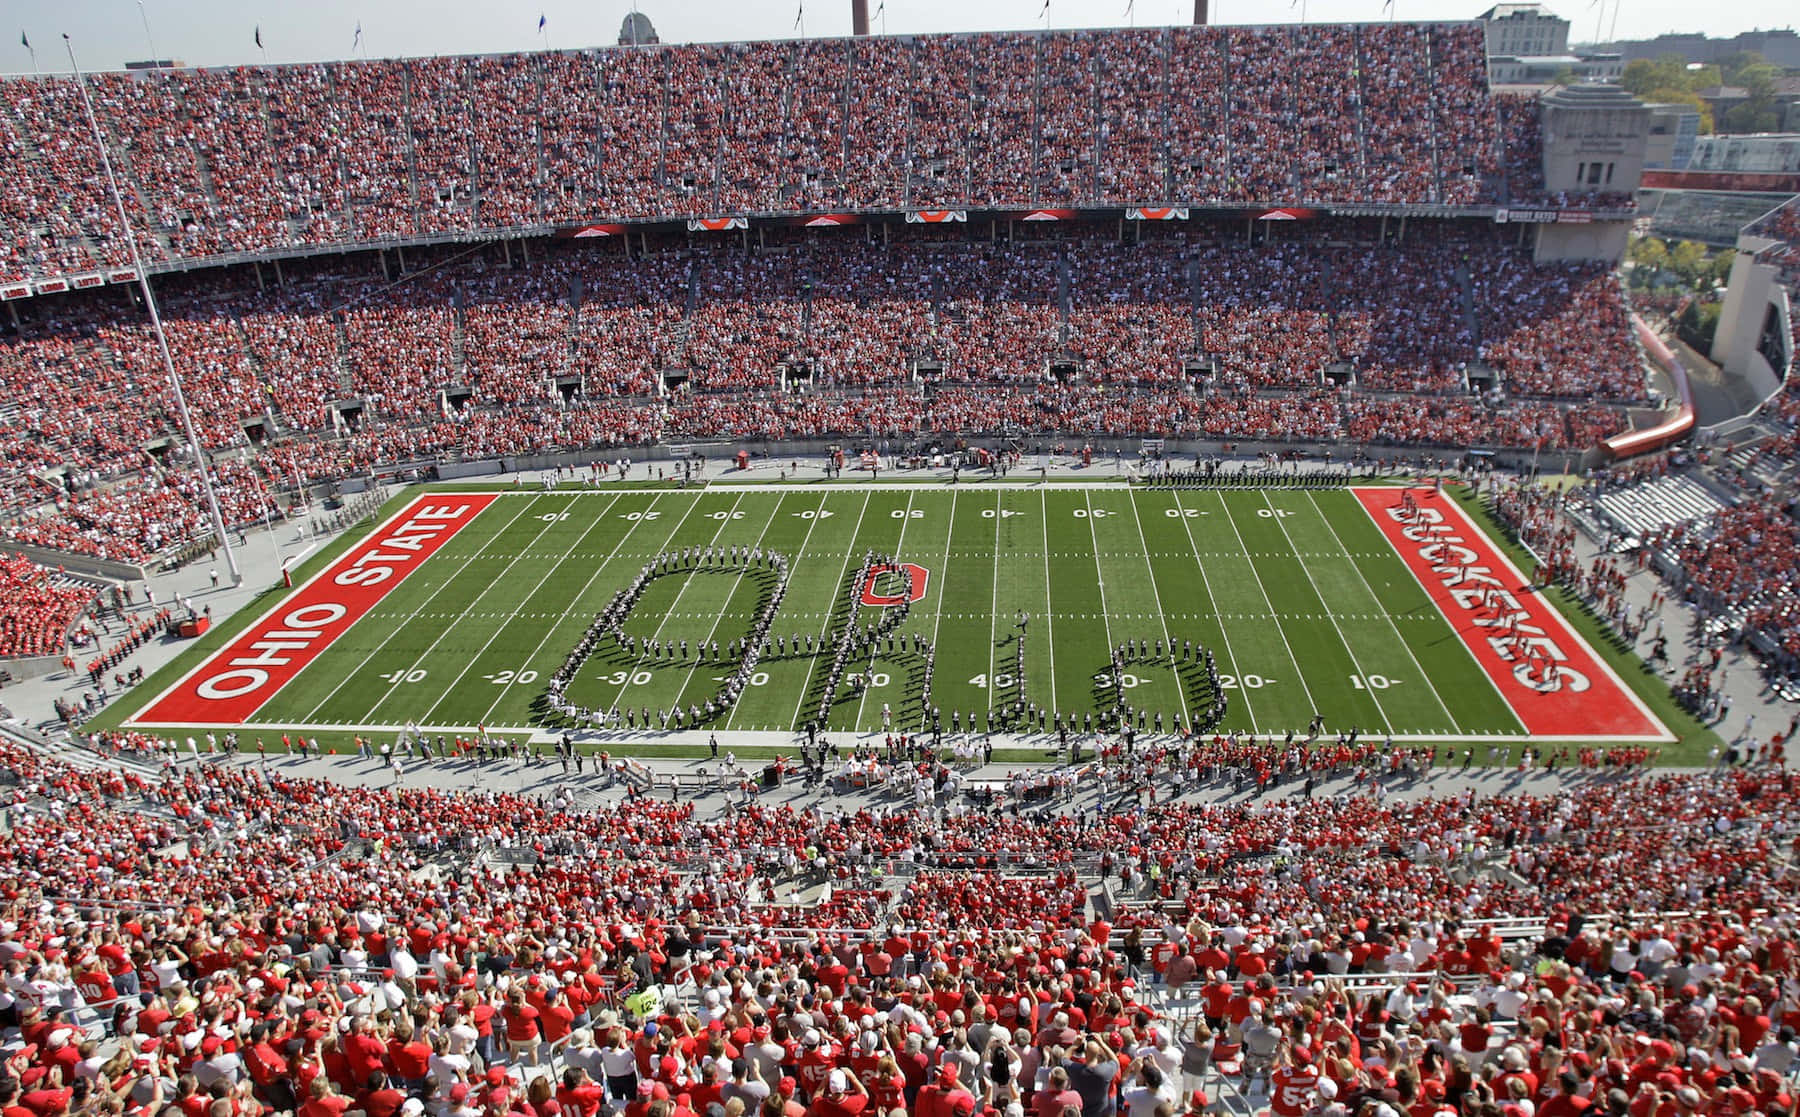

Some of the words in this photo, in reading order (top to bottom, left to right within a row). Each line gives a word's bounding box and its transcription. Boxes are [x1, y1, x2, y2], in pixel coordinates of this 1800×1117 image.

[196, 603, 348, 700] OHIO
[333, 503, 471, 587] STATE
[1384, 507, 1591, 693] BUCKEYES
[388, 669, 428, 683] 10
[491, 670, 539, 684] 20
[608, 671, 653, 685] 30
[968, 673, 1014, 688] 40
[1094, 674, 1139, 689] 30
[1219, 674, 1264, 689] 20
[1349, 674, 1391, 689] 10
